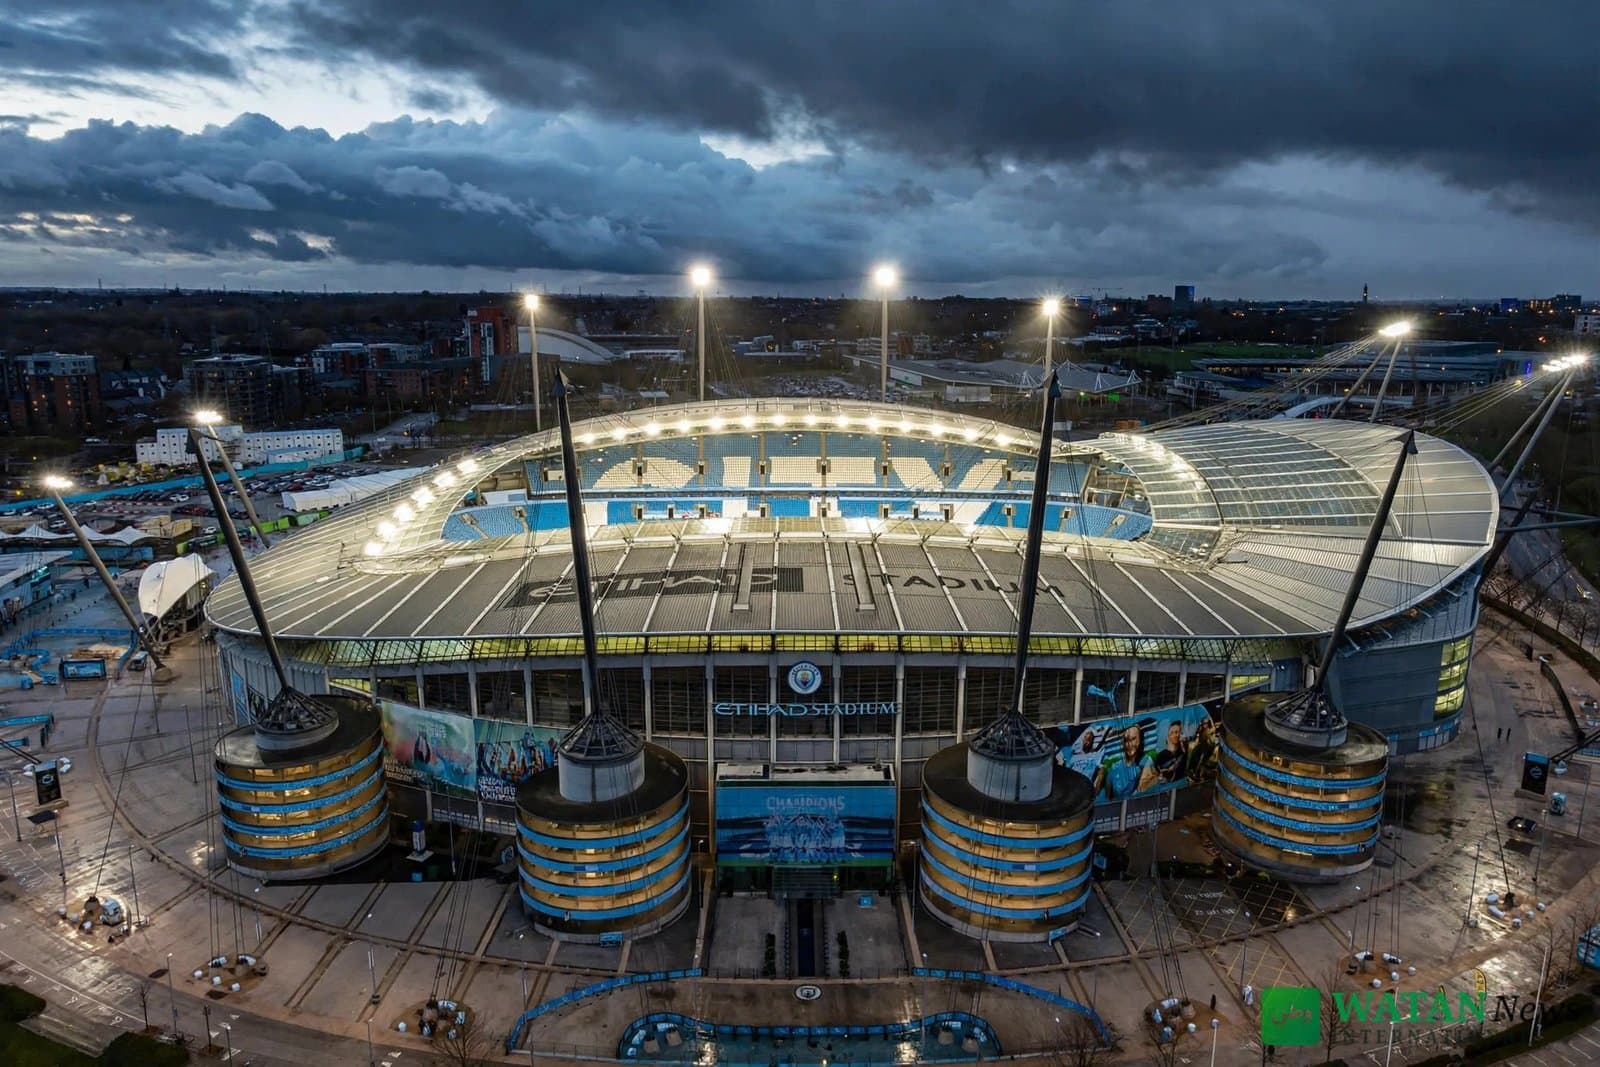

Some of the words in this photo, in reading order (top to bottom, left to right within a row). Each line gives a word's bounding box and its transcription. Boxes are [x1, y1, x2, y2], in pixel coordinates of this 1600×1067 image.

[715, 703, 808, 717] ETIHAD
[811, 702, 897, 715] STADIUM
[767, 795, 846, 811] CHAMPIONS
